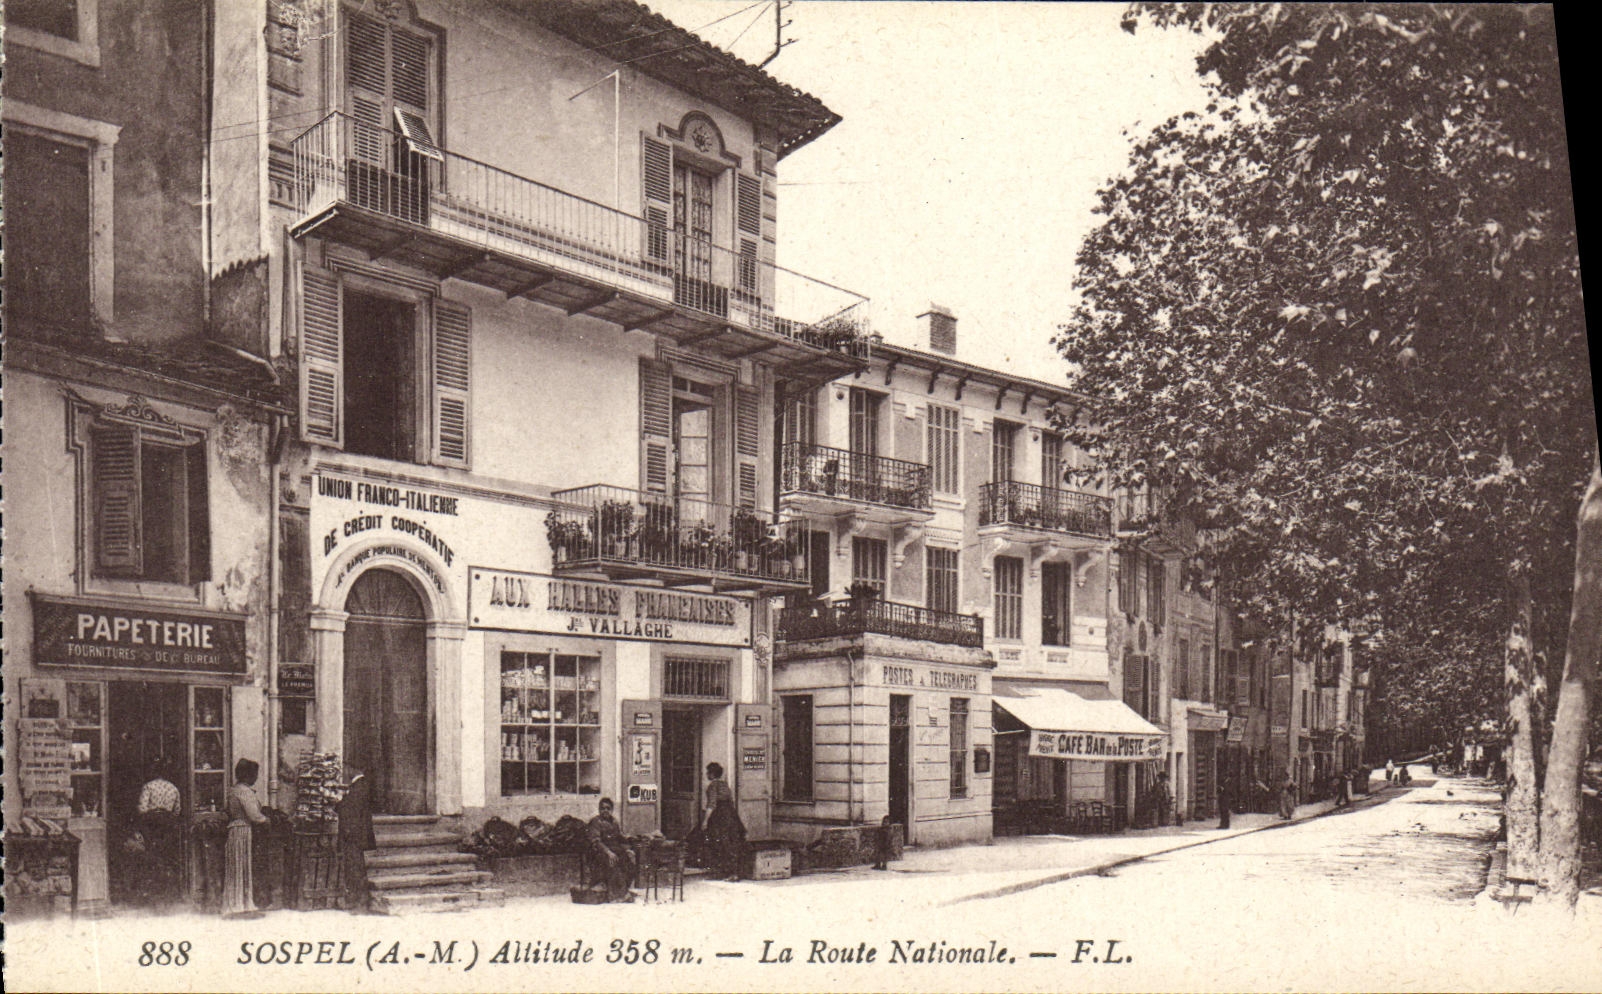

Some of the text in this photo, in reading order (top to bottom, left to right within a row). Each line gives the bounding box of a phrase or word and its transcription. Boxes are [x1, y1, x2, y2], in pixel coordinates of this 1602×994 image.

[318, 476, 459, 516] UNION FRANCO-ITALIENNE
[324, 510, 455, 568] DE CRÉDIT COOPÉRATIF
[346, 549, 370, 573] BANQUE
[373, 546, 406, 558] POPULAIRE
[408, 552, 416, 563] DE
[489, 575, 531, 608] AUX
[547, 581, 621, 617] HALLES
[77, 613, 214, 649] PAPETERIE
[67, 643, 220, 665] FOURNITURES DE BUREAU
[883, 666, 914, 686] POSTES
[1085, 735, 1105, 755] BAR
[1117, 736, 1144, 756] POSTE
[744, 755, 765, 763] MENIER
[641, 788, 657, 801] KUB
